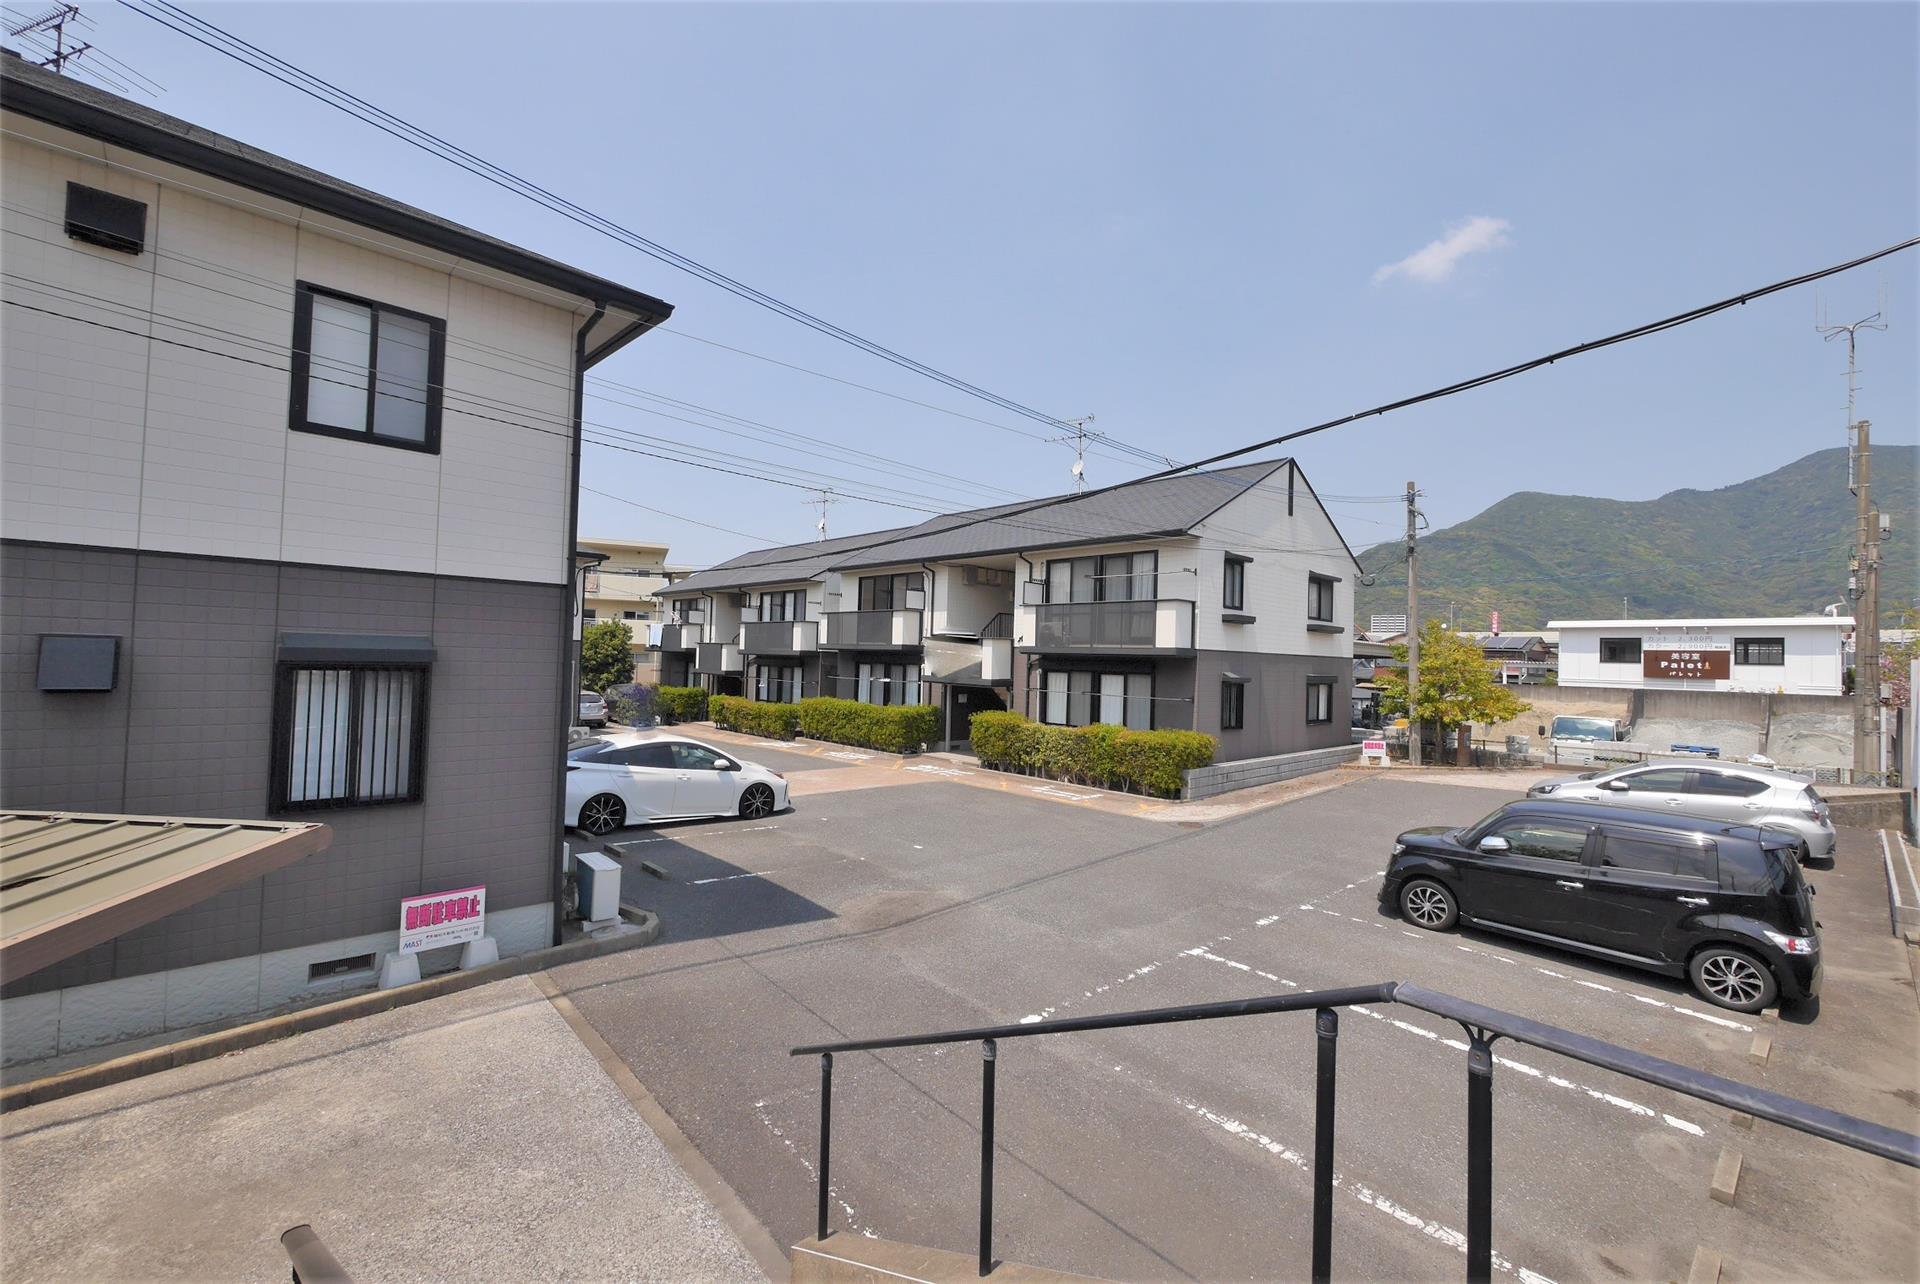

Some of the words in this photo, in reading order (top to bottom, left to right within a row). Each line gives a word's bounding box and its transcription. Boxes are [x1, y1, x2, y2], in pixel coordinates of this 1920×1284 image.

[1671, 652, 1700, 660] 美容室
[405, 895, 480, 931] 無断駐車禁止
[402, 939, 423, 950] MAST
